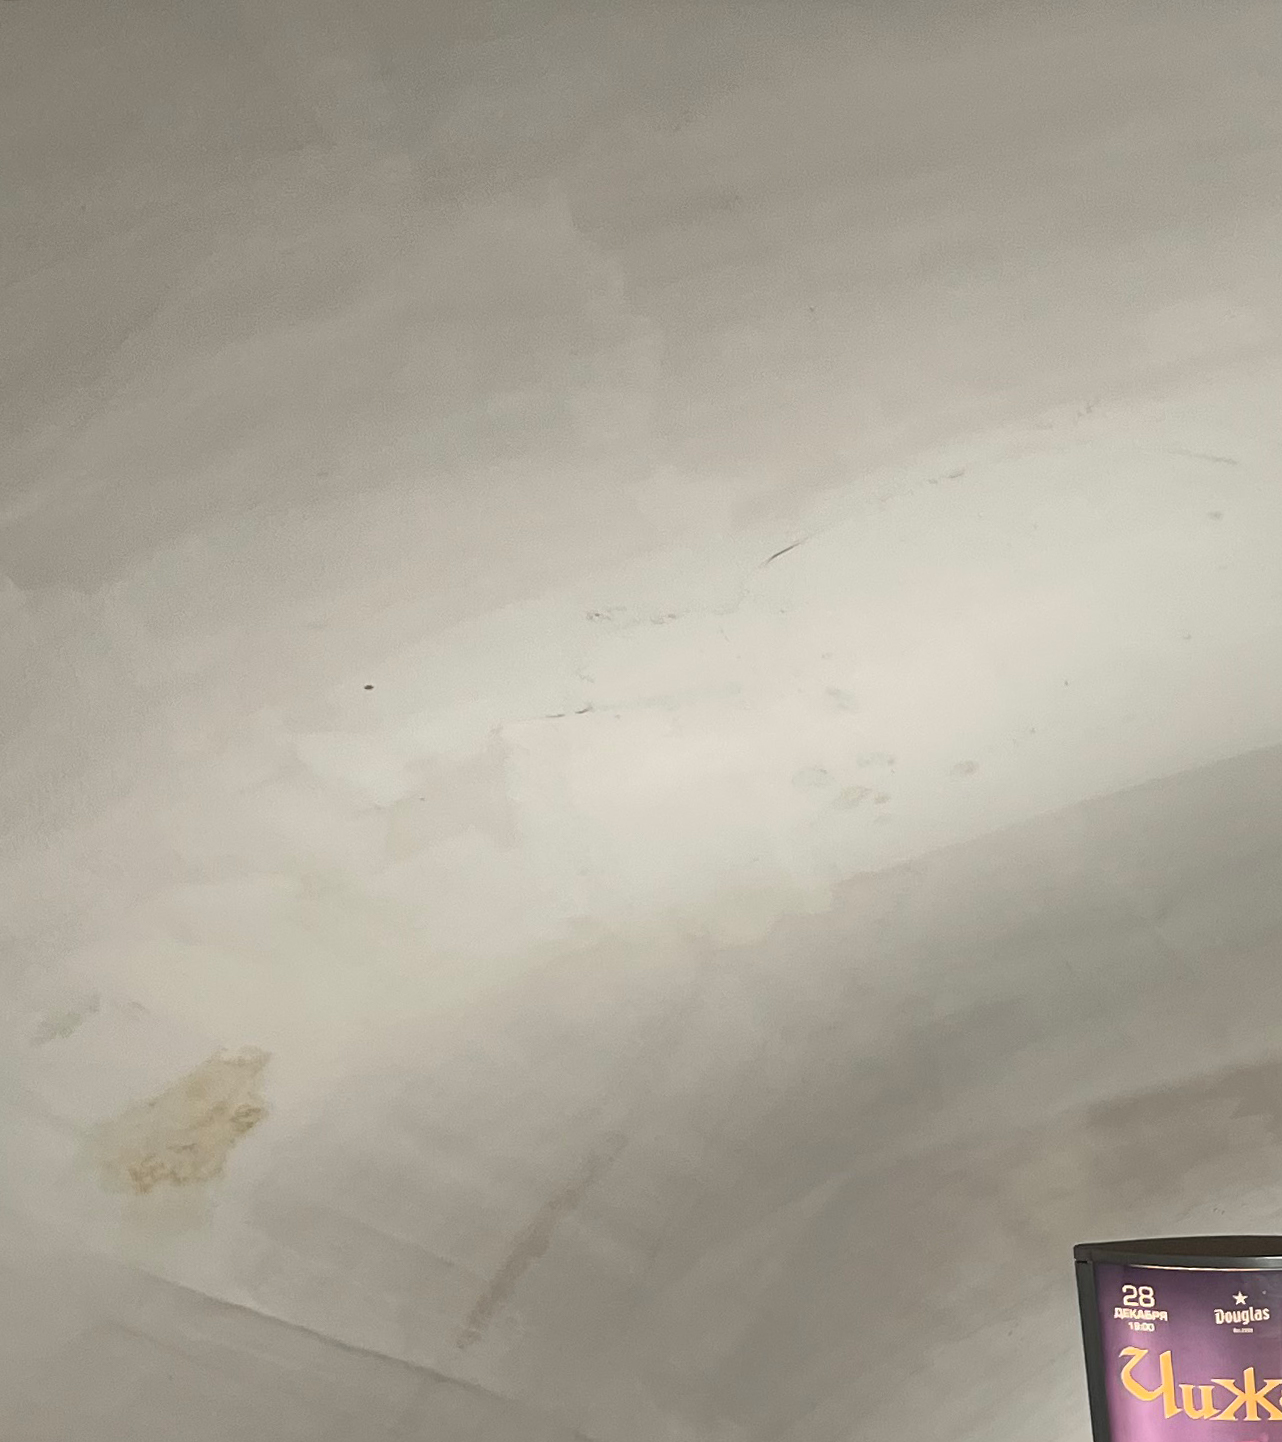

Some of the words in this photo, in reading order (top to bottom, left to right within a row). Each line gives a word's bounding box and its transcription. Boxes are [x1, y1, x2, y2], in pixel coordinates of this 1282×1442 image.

[1121, 1284, 1156, 1308] 28
[1113, 1307, 1169, 1322] ДЕКАБРЯ
[1213, 1306, 1271, 1325] Douglas
